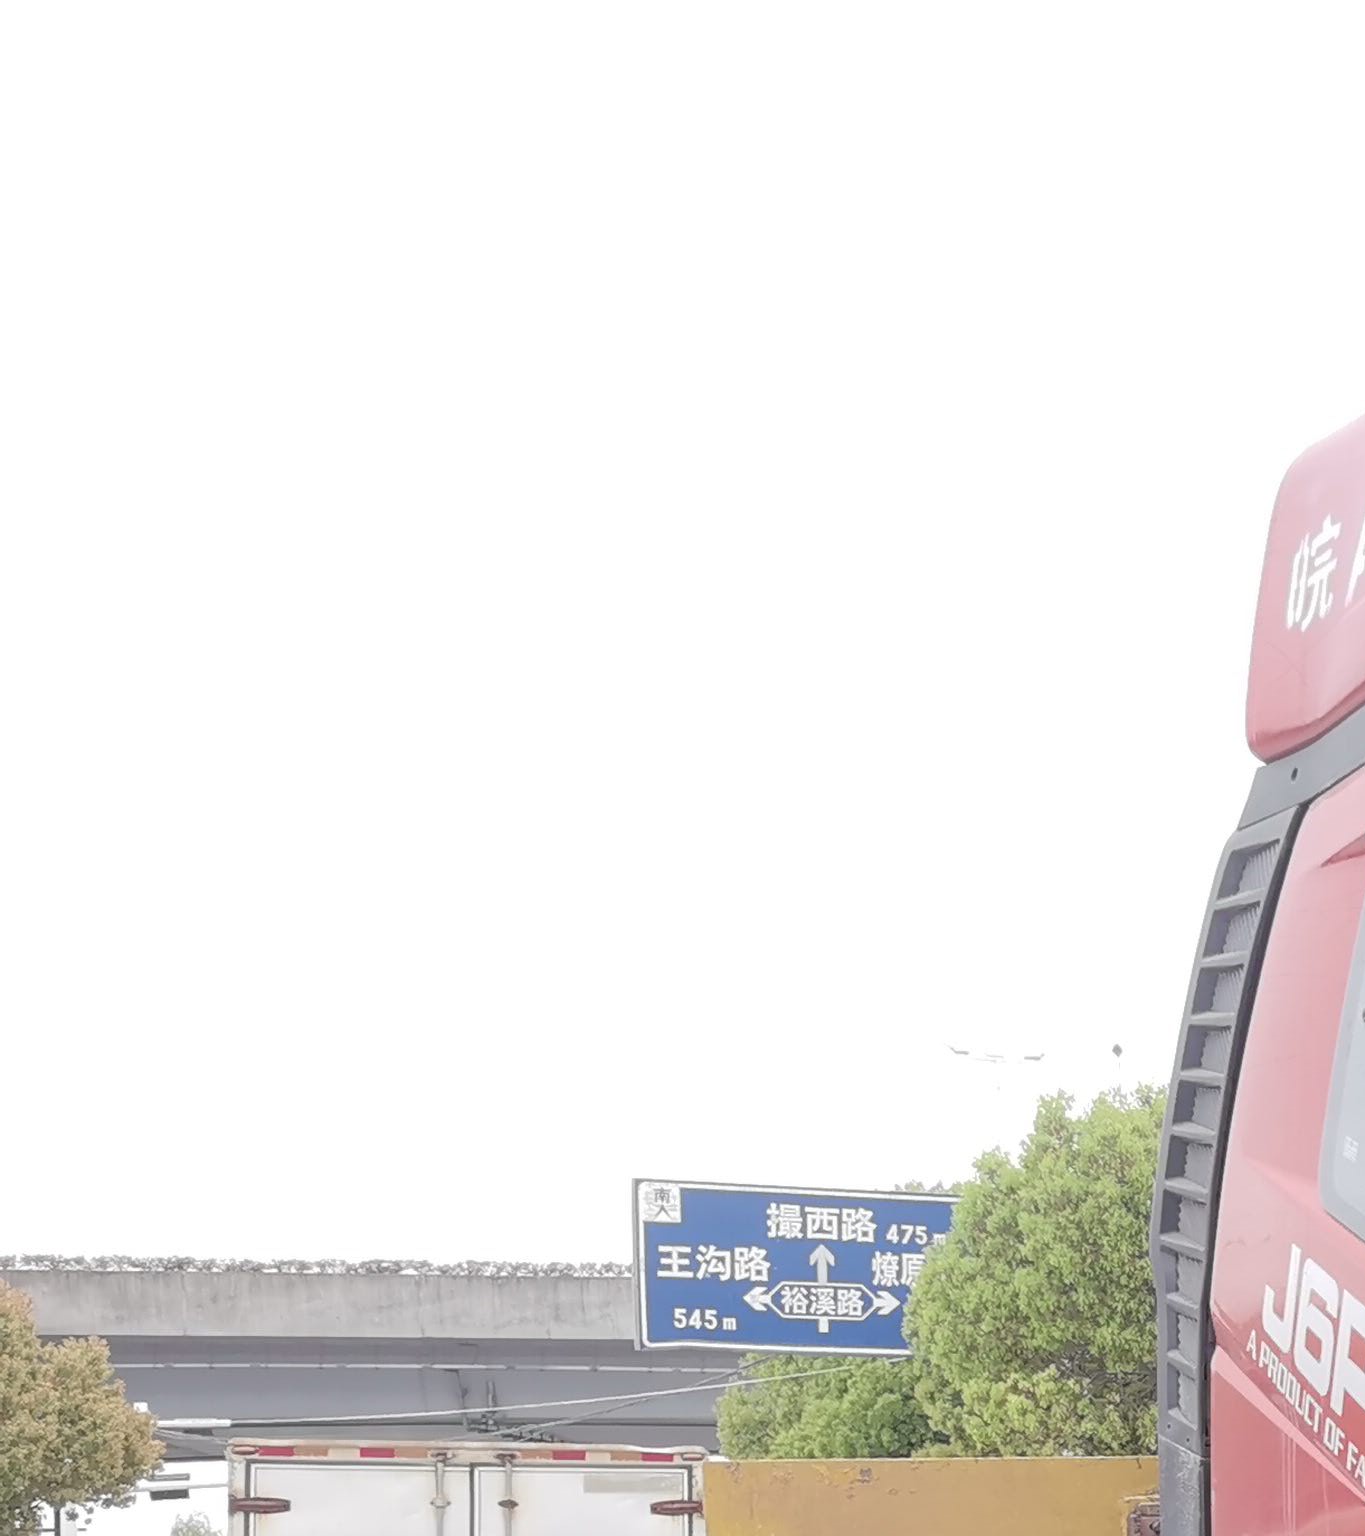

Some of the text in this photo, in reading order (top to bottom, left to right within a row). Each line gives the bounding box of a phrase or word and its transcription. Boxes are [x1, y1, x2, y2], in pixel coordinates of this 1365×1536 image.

[766, 1202, 878, 1243] 撮西路
[657, 1245, 771, 1282] 王沟路
[780, 1287, 865, 1317] 裕溪路
[1246, 1329, 1258, 1360] A
[1259, 1341, 1323, 1433] PRODUCT
[1323, 1417, 1346, 1457] OF
